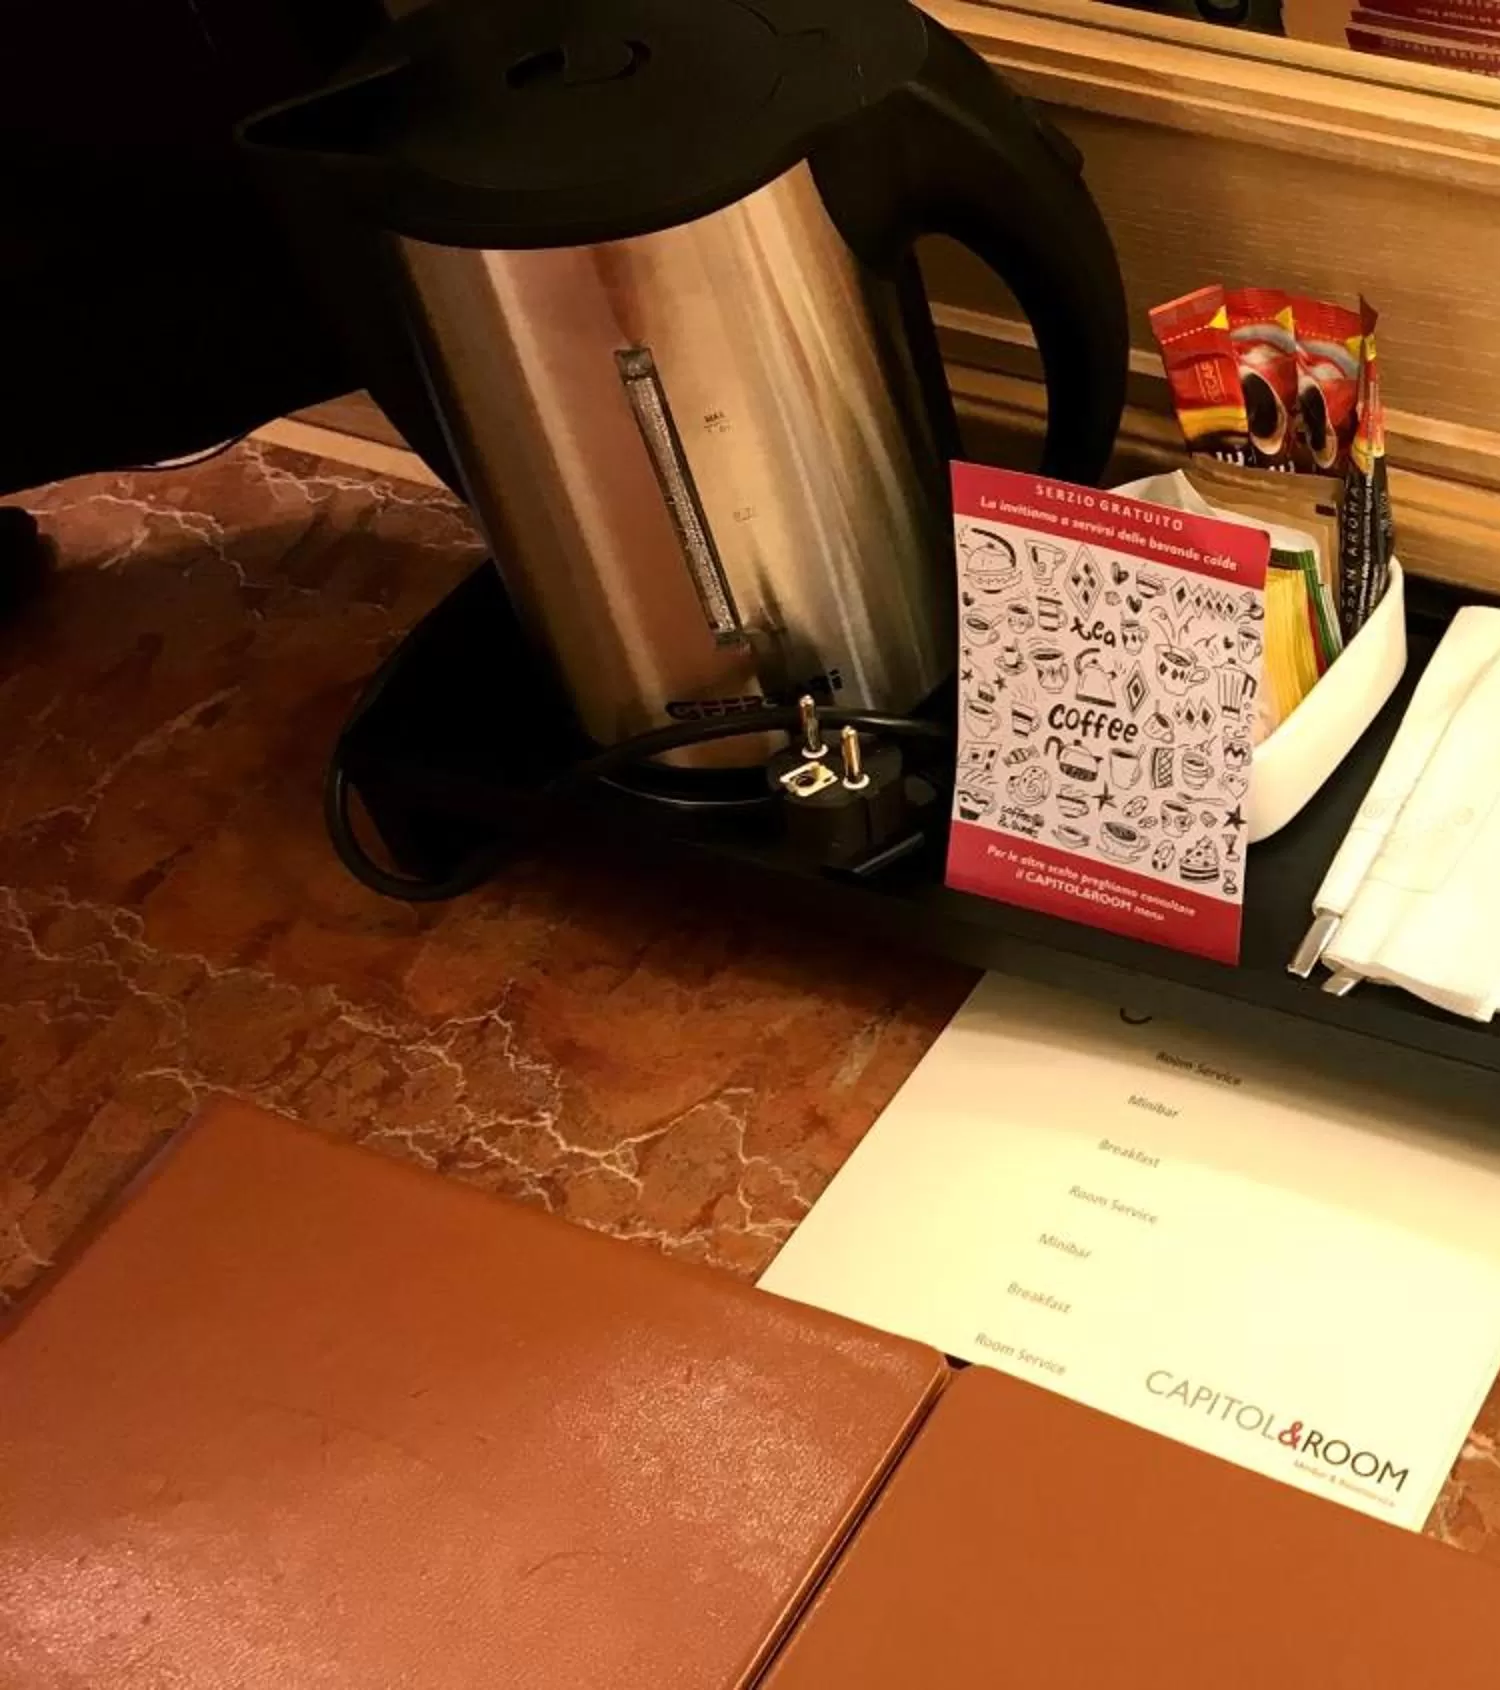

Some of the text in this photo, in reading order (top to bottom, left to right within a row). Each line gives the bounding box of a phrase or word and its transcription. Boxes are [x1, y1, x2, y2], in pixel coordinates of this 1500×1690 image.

[1099, 499, 1183, 531] GRATUITO
[999, 500, 1059, 523] invitiamo
[1117, 529, 1146, 547] delle
[1149, 536, 1201, 561] bevande
[1203, 554, 1238, 571] calde
[1070, 616, 1117, 648] tea
[1156, 1050, 1242, 1086] Room Service
[1128, 1094, 1179, 1119] Minibar
[1098, 1138, 1160, 1168] Breakfast
[1068, 1184, 1158, 1225] Room Service
[1038, 1232, 1092, 1260] Minibar
[1007, 1281, 1072, 1315] Breakfast
[974, 1332, 1067, 1376] Room Service
